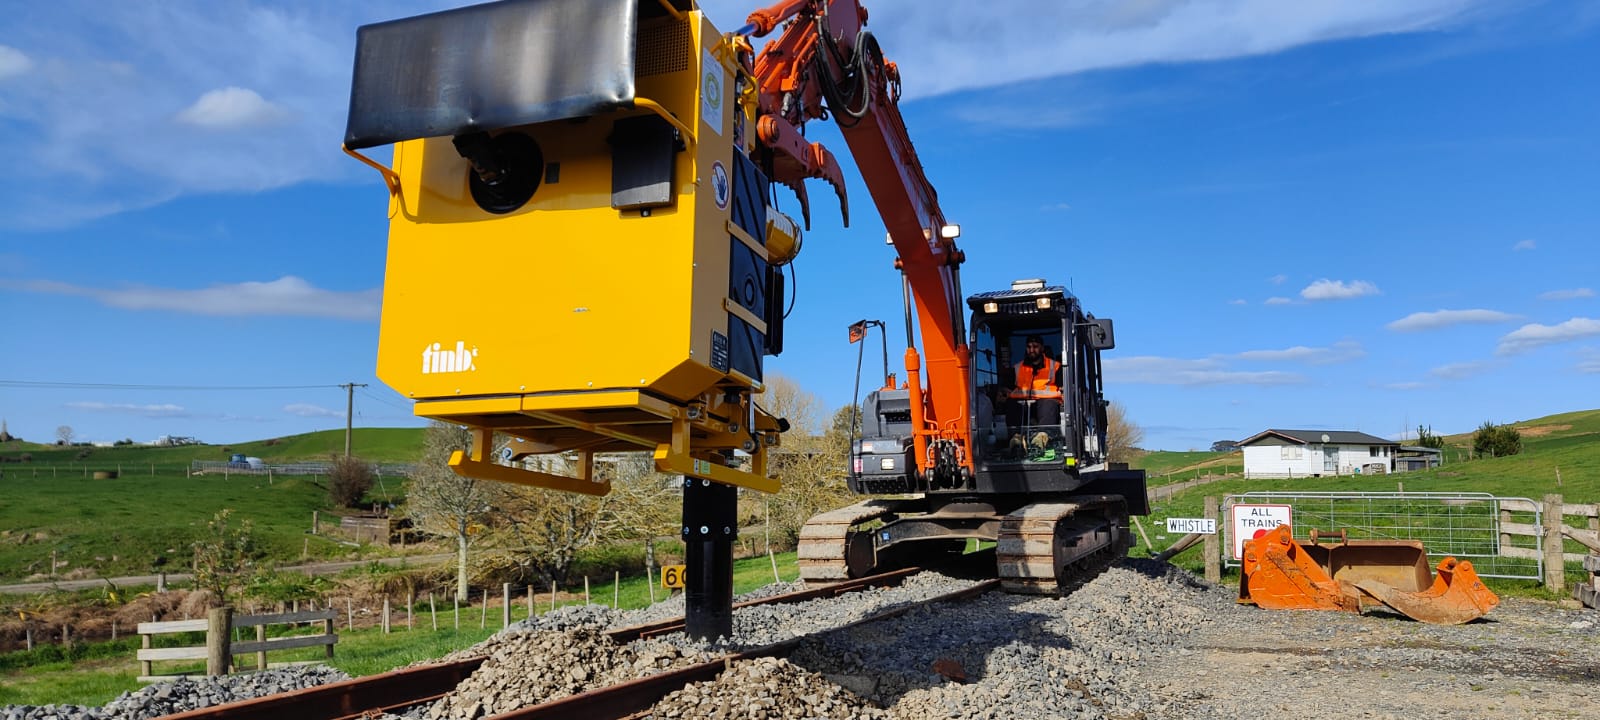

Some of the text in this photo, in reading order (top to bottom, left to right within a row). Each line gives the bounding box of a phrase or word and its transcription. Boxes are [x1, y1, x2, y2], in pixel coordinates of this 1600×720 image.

[1251, 508, 1272, 516] ALL
[1169, 519, 1214, 532] WHISTLE
[1241, 518, 1282, 528] TRAINS
